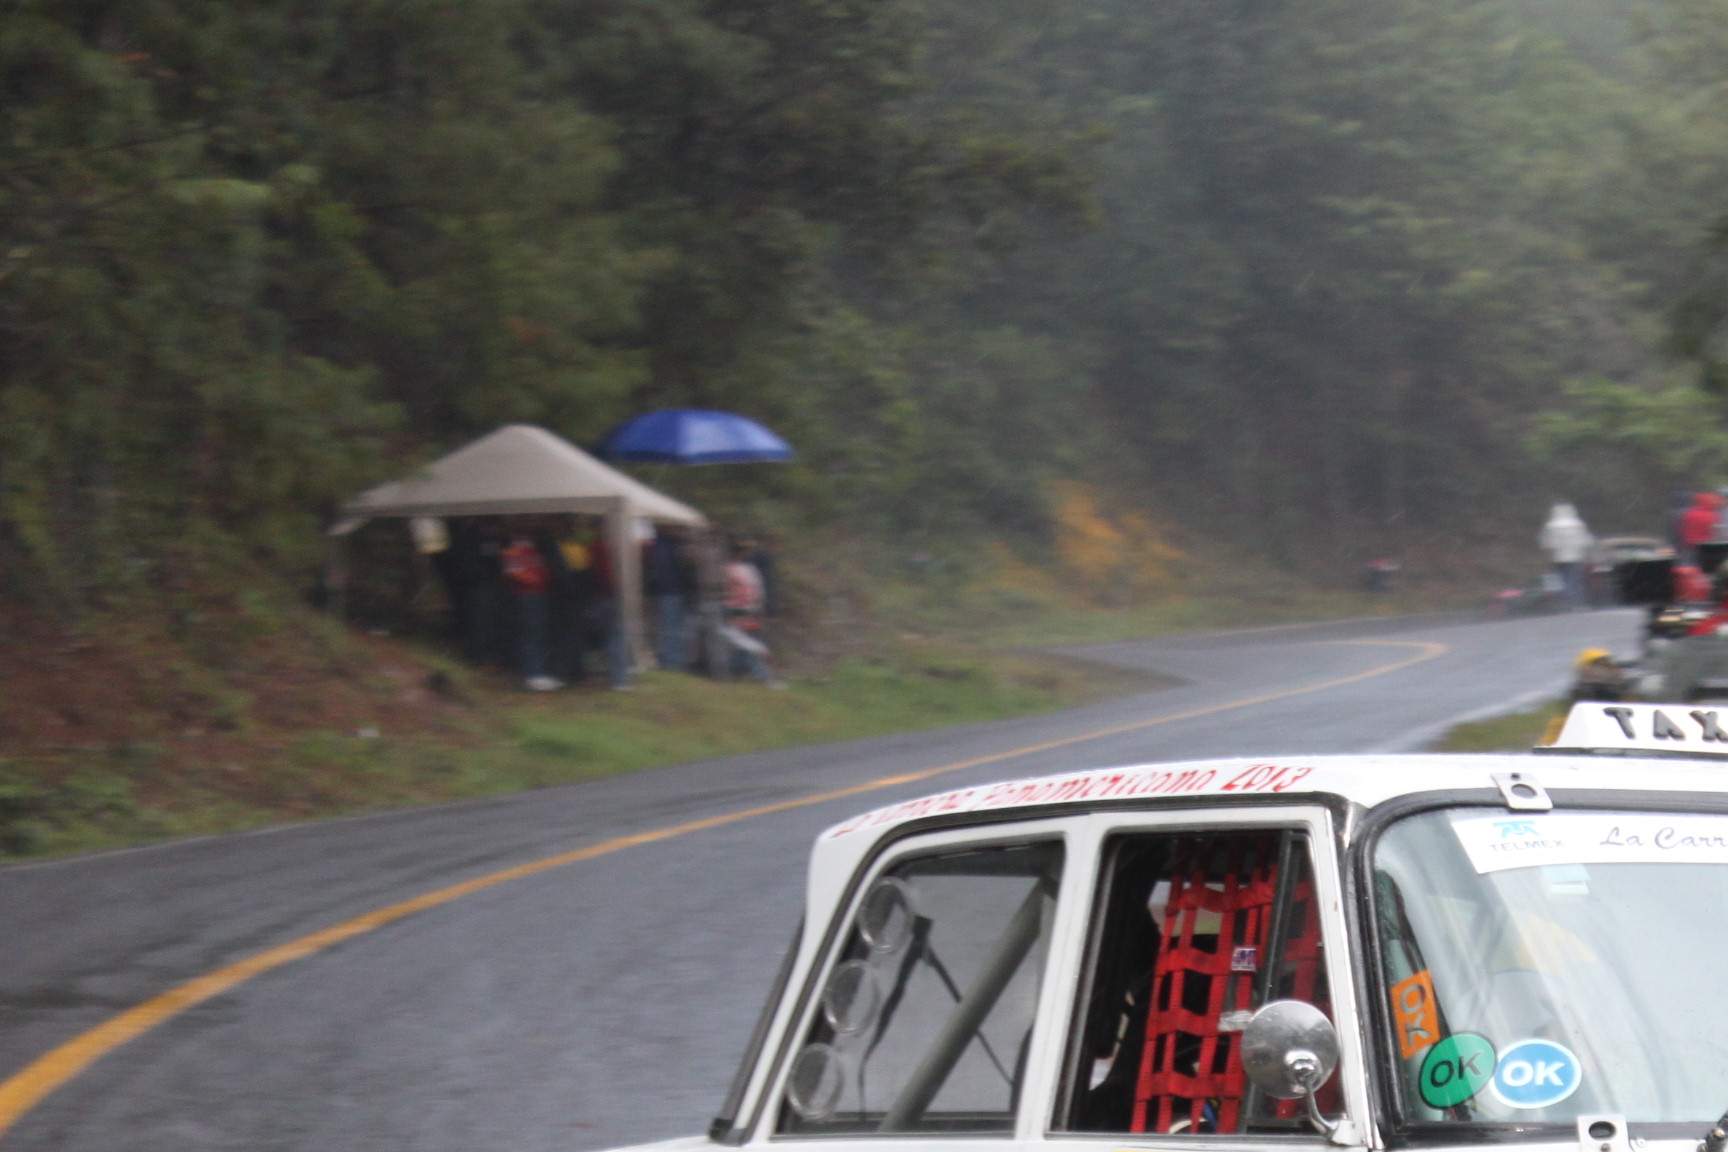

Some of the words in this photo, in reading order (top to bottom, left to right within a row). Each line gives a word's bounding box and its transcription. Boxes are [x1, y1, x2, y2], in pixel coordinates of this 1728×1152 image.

[1220, 764, 1316, 794] 2013
[1489, 839, 1566, 852] TELMEX
[1600, 826, 1641, 847] La
[1400, 984, 1431, 1047] OK
[1430, 1052, 1483, 1088] OK
[1502, 1060, 1566, 1087] OK
